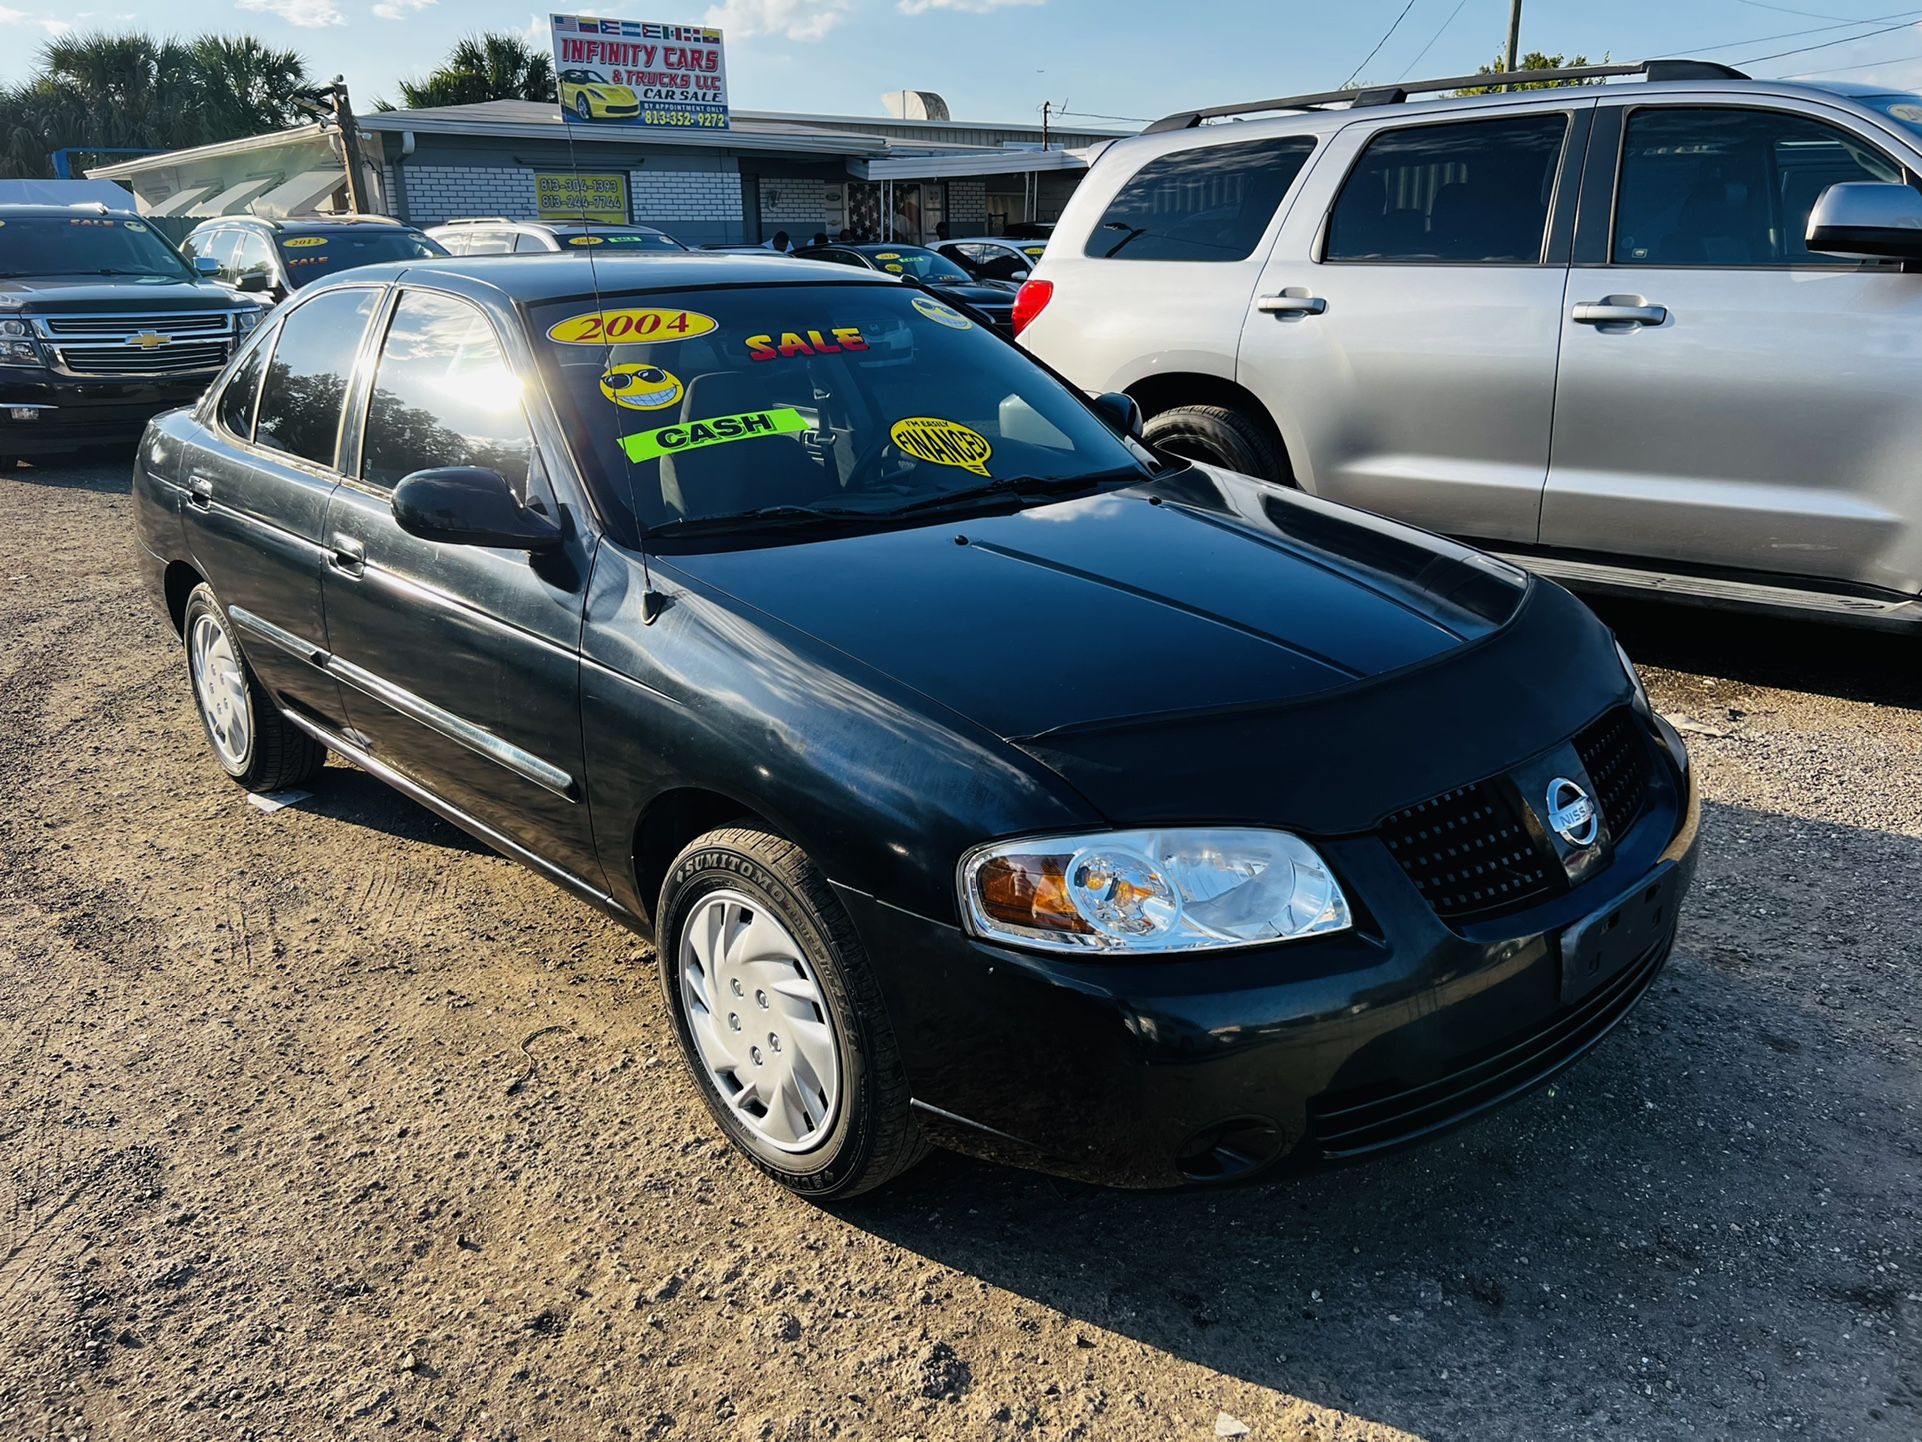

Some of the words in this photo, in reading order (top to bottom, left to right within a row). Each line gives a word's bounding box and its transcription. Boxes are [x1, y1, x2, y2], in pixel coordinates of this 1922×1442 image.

[561, 37, 657, 67] INFINITY
[662, 46, 719, 72] CARS
[612, 69, 623, 84] &
[624, 70, 691, 88] TRUCKS
[643, 88, 675, 100] CAR
[679, 90, 723, 103] SALE
[655, 103, 704, 112] APPOINTMENT
[288, 256, 329, 269] SALE
[574, 312, 690, 342] 2004
[744, 327, 870, 361] SALE
[656, 413, 777, 449] CASH
[922, 420, 950, 428] EASILY
[895, 428, 988, 463] FINANCED
[1560, 803, 1592, 827] NISS
[685, 853, 786, 902] SUMITOMO
